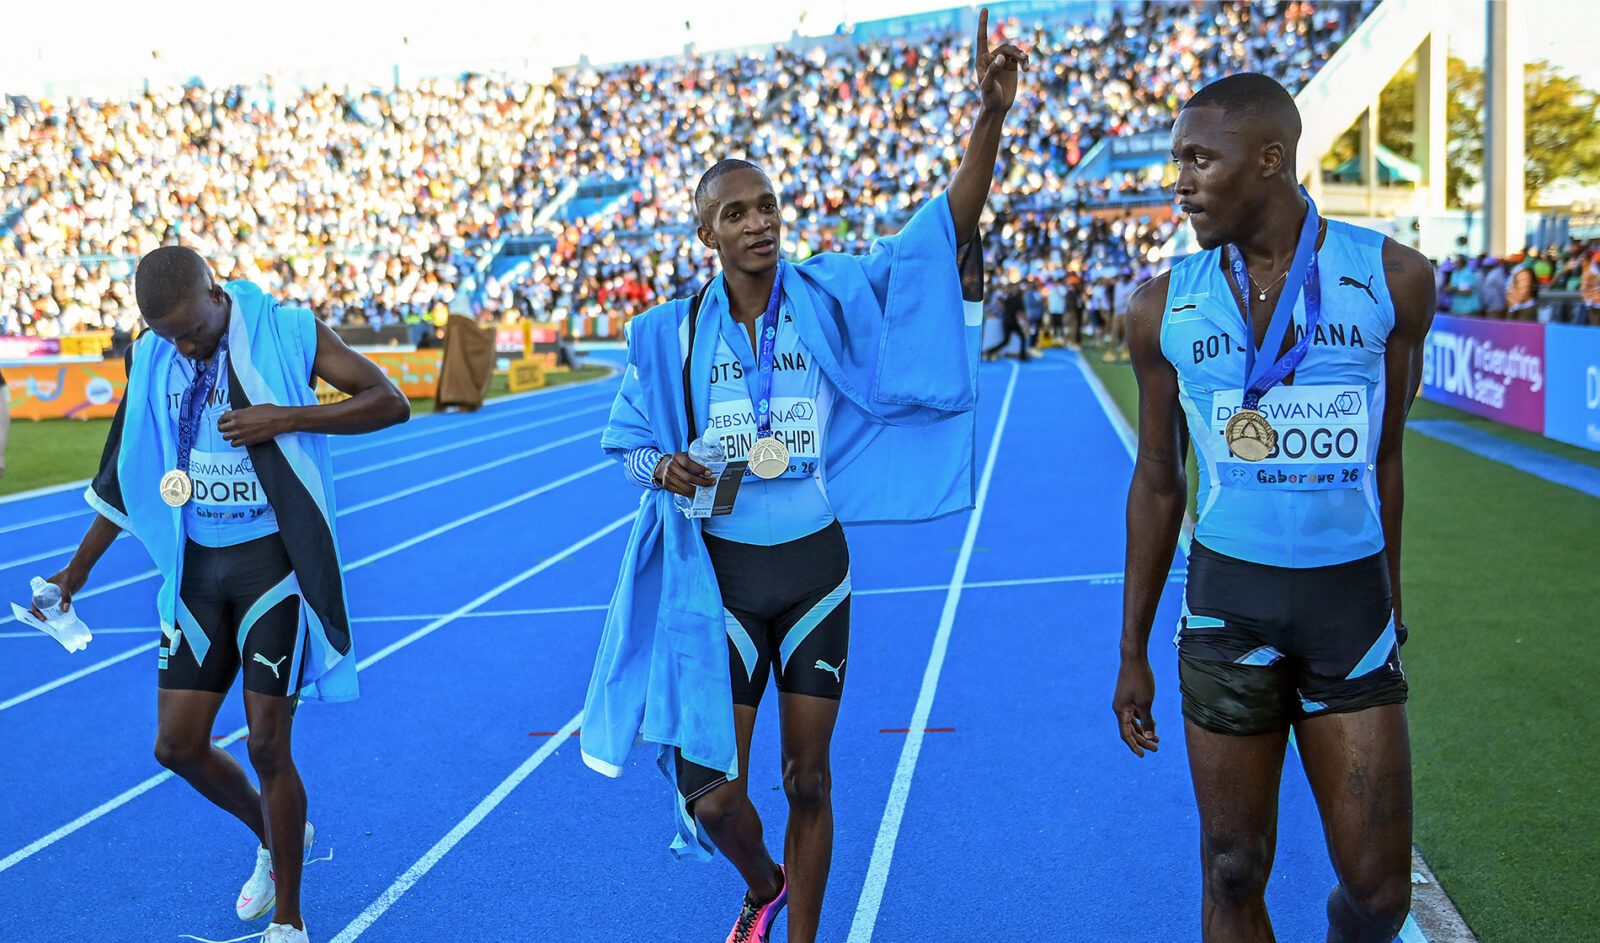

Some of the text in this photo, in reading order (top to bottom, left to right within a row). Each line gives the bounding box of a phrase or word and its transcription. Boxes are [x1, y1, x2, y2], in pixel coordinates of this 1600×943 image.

[1433, 331, 1473, 399] TDK
[1217, 402, 1338, 421] DSWANA
[801, 461, 815, 474] 26
[1257, 468, 1359, 484] Gaborone 26
